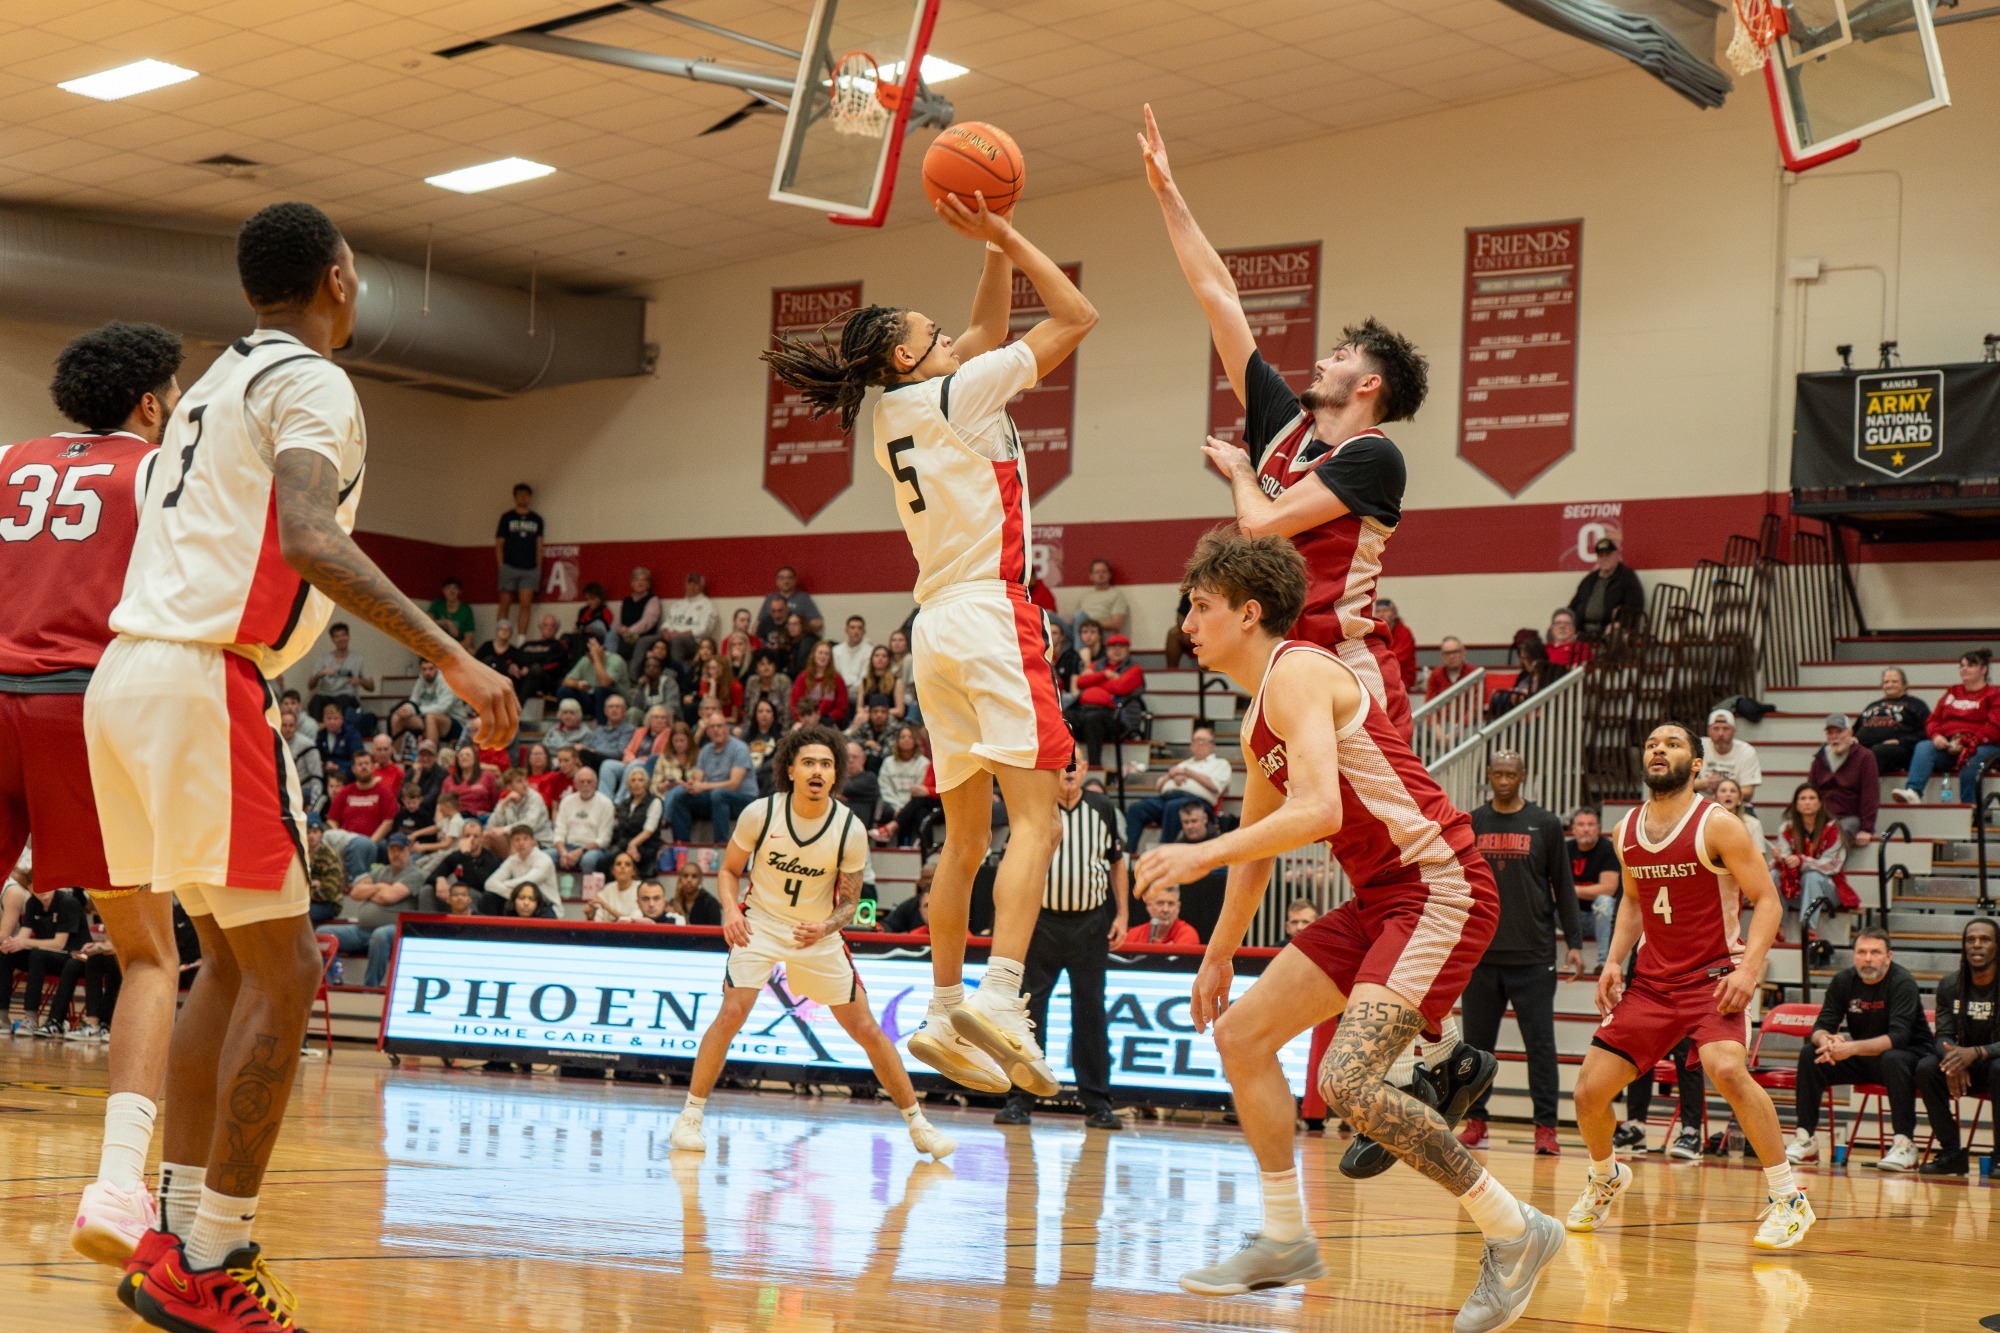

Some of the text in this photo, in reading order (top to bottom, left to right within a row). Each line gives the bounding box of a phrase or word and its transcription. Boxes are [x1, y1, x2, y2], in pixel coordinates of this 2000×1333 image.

[1477, 230, 1570, 256] FRIENDS
[1224, 251, 1310, 276] FRIENDS
[1473, 251, 1568, 270] UNIVERSITY
[1236, 272, 1309, 288] NIVERSITY
[781, 290, 854, 314] FRIENDS
[1881, 379, 1918, 390] KANSAS
[1867, 393, 1932, 415] ARMY
[1865, 412, 1932, 427] NATIONAL
[1864, 424, 1933, 445] GUARD
[887, 435, 926, 514] 5
[0, 463, 116, 542] 35
[1563, 503, 1622, 519] SECTION
[546, 560, 568, 595] A
[767, 851, 827, 877] Falcons
[784, 878, 802, 907] 4
[1652, 886, 1673, 925] 4
[407, 976, 843, 1063] PHOENX
[454, 1025, 788, 1056] HOME CARE & HOICE
